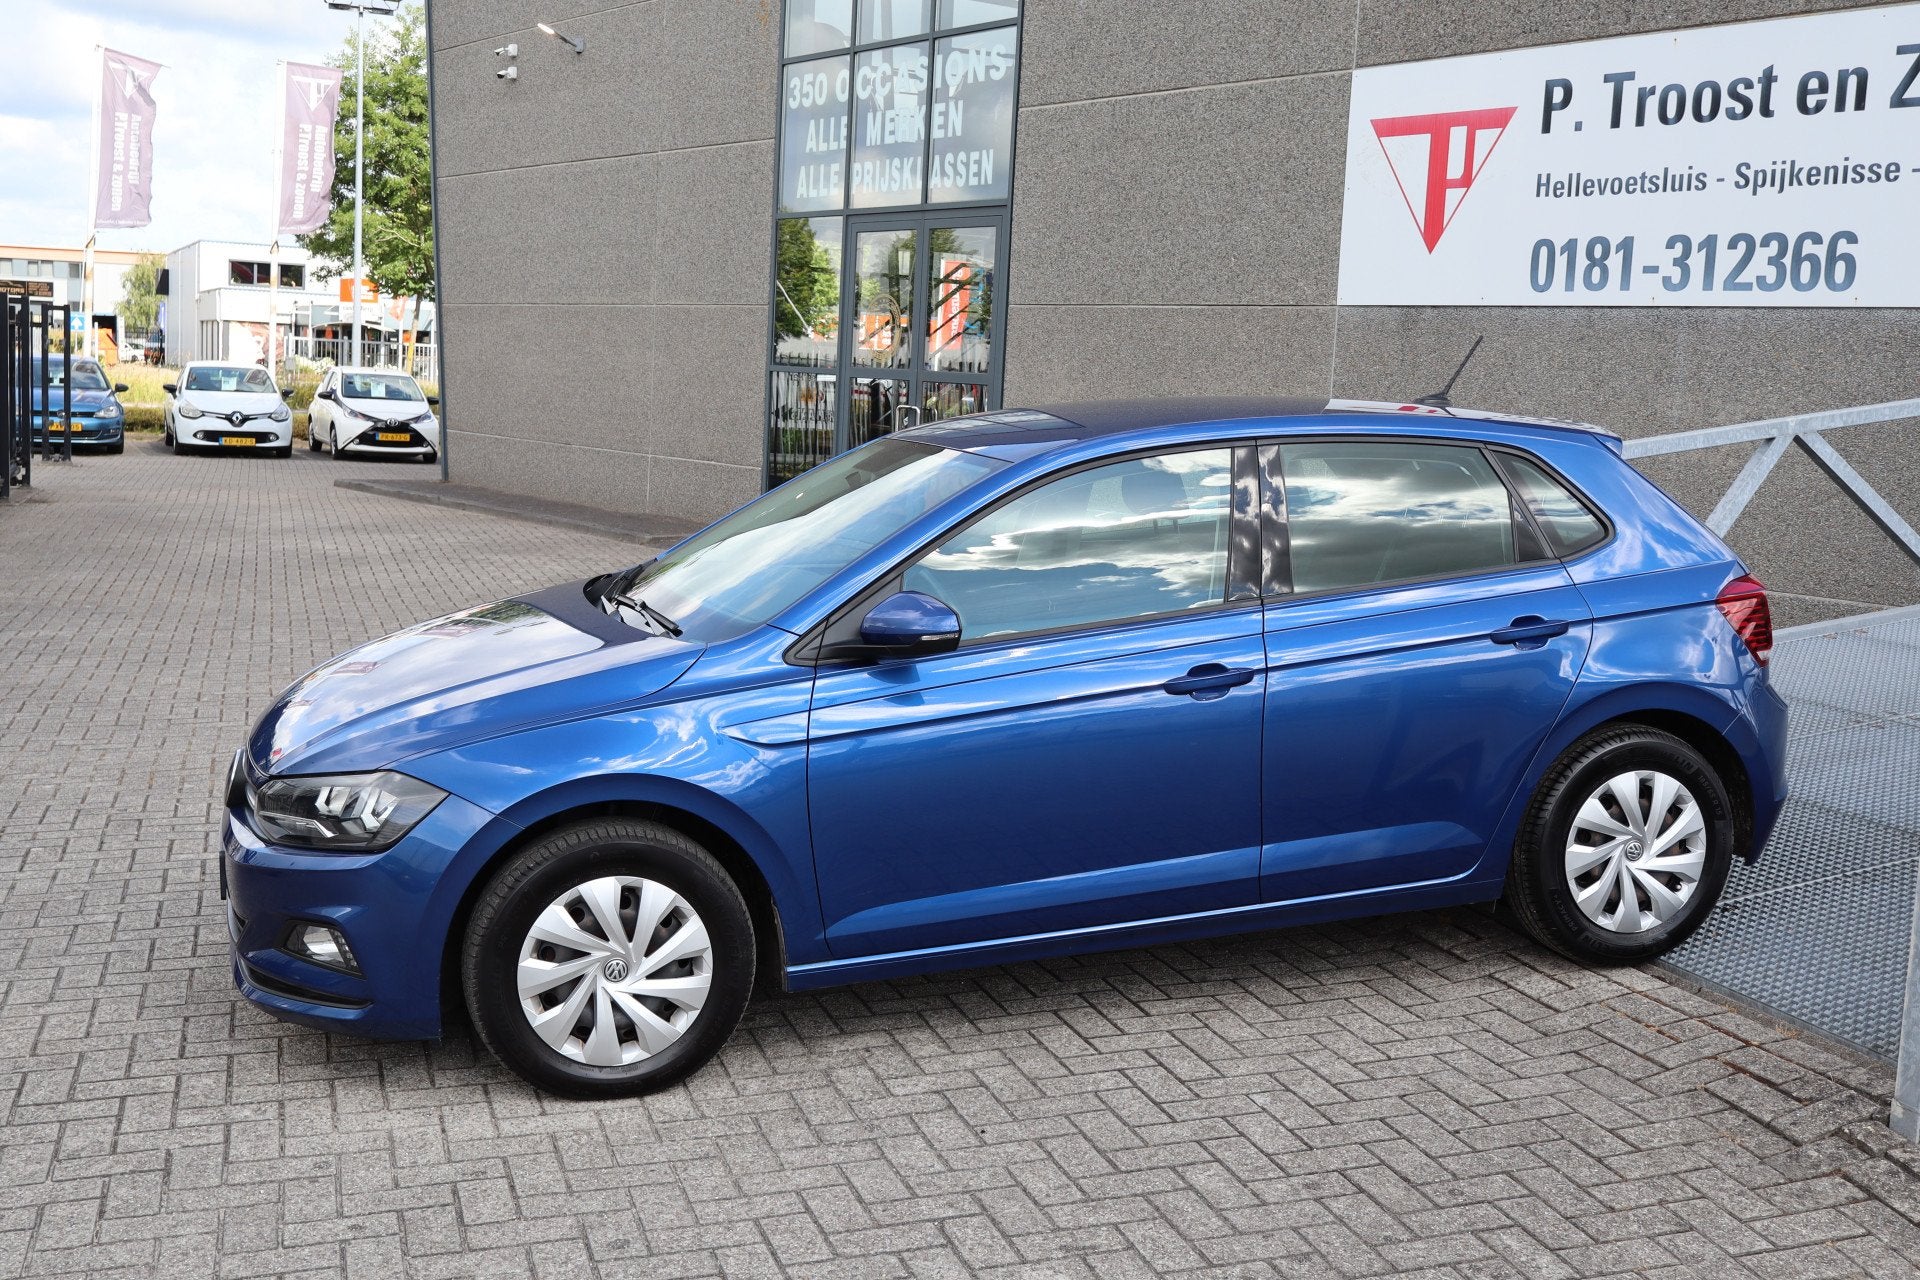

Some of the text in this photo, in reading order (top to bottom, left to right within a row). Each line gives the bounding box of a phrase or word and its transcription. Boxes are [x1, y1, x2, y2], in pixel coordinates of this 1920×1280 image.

[789, 44, 1007, 109] 350 OCCASIONS
[1541, 78, 1582, 134] P.
[1604, 65, 1778, 129] Troost
[1797, 67, 1868, 115] en
[805, 100, 963, 153] ALLE MERKEN
[796, 149, 994, 198] ALLE PRIJSKLASSEN
[1536, 166, 1707, 198] Hellevoetsluis
[1735, 157, 1900, 196] Spijkenisse
[1530, 231, 1858, 292] 0181-312366
